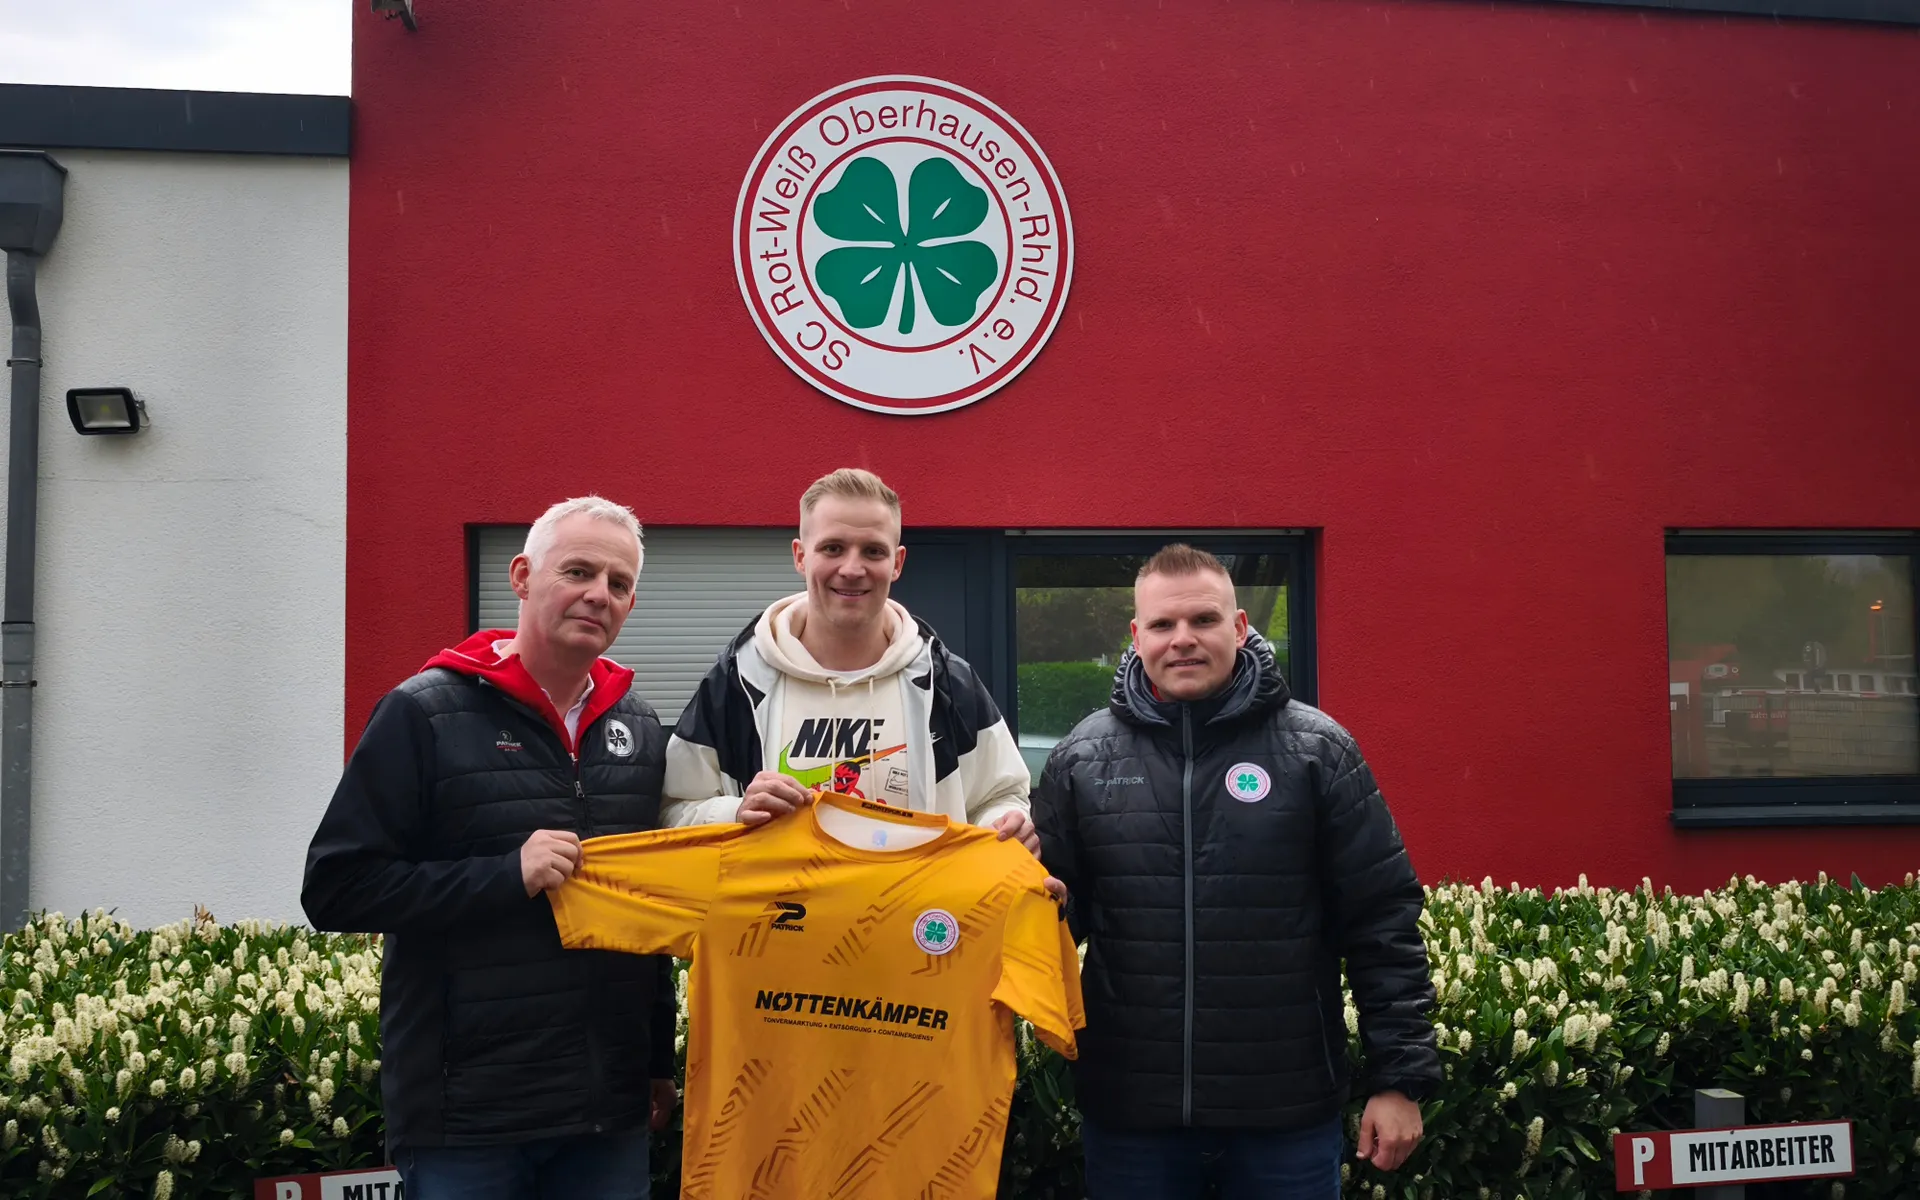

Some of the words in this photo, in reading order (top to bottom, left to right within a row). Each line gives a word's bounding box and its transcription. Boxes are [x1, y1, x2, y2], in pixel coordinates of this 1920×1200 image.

[819, 99, 1051, 304] Oberhausen-Rhld.
[756, 145, 816, 316] Rot-Weiß
[796, 321, 850, 370] SC
[959, 318, 1015, 374] e.V.
[790, 718, 885, 758] NIKE
[1106, 776, 1144, 786] PATRICK
[771, 923, 804, 932] PATRICK
[763, 1016, 822, 1028] TONVERMARKTUNG
[829, 1023, 871, 1033] ENTSORGUNG
[878, 1029, 934, 1042] CONTAINERDIENST
[1632, 1137, 1654, 1186] P
[1689, 1134, 1835, 1172] MITARBEITER
